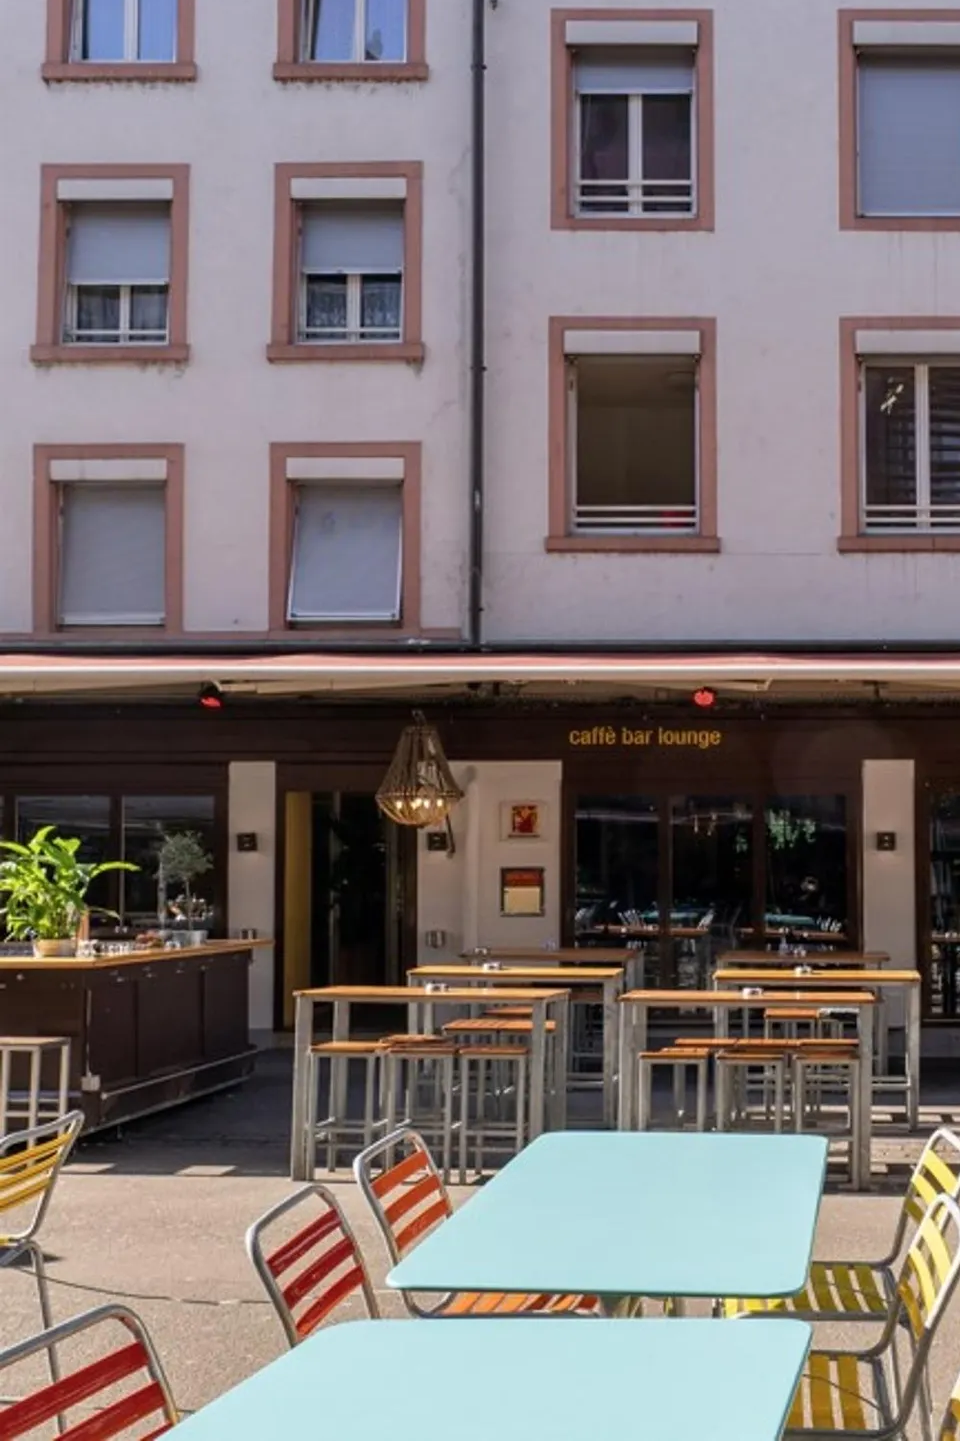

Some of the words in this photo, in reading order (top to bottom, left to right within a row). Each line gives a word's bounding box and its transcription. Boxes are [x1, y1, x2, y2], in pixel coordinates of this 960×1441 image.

[569, 726, 616, 745] caffè
[621, 727, 653, 745] bar
[658, 726, 721, 749] lounge
